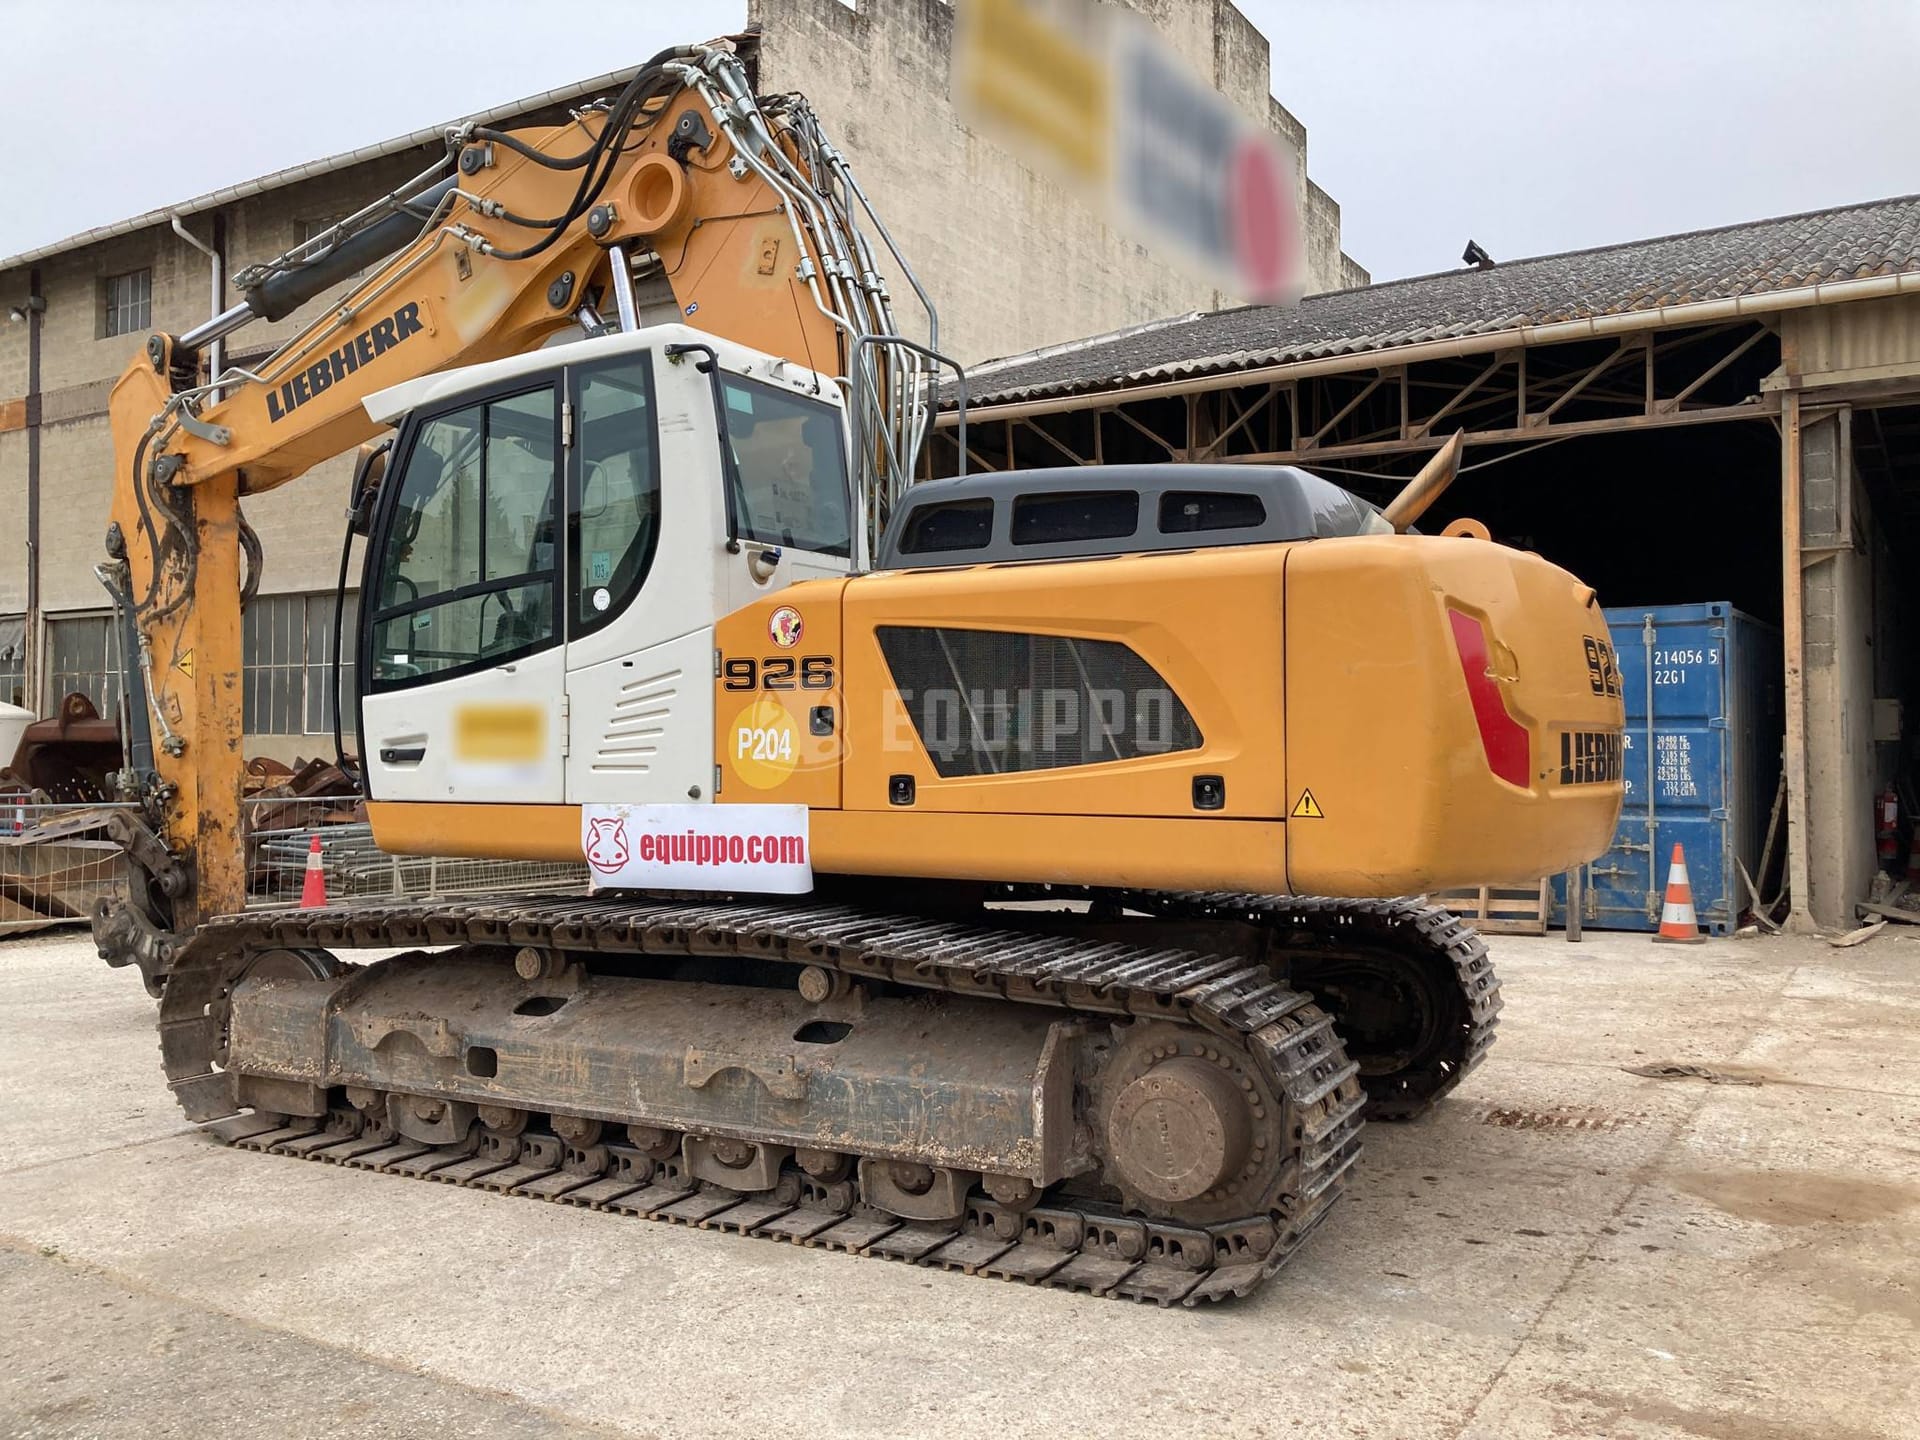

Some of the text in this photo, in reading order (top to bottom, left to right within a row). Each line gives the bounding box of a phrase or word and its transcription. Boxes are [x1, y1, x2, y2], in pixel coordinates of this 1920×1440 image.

[266, 301, 424, 424] LIEBHERR
[723, 655, 834, 692] 926
[1654, 649, 1718, 665] 214056 5
[1654, 670, 1686, 685] 22G1
[737, 727, 791, 761] P204
[640, 829, 805, 867] equippo.com
